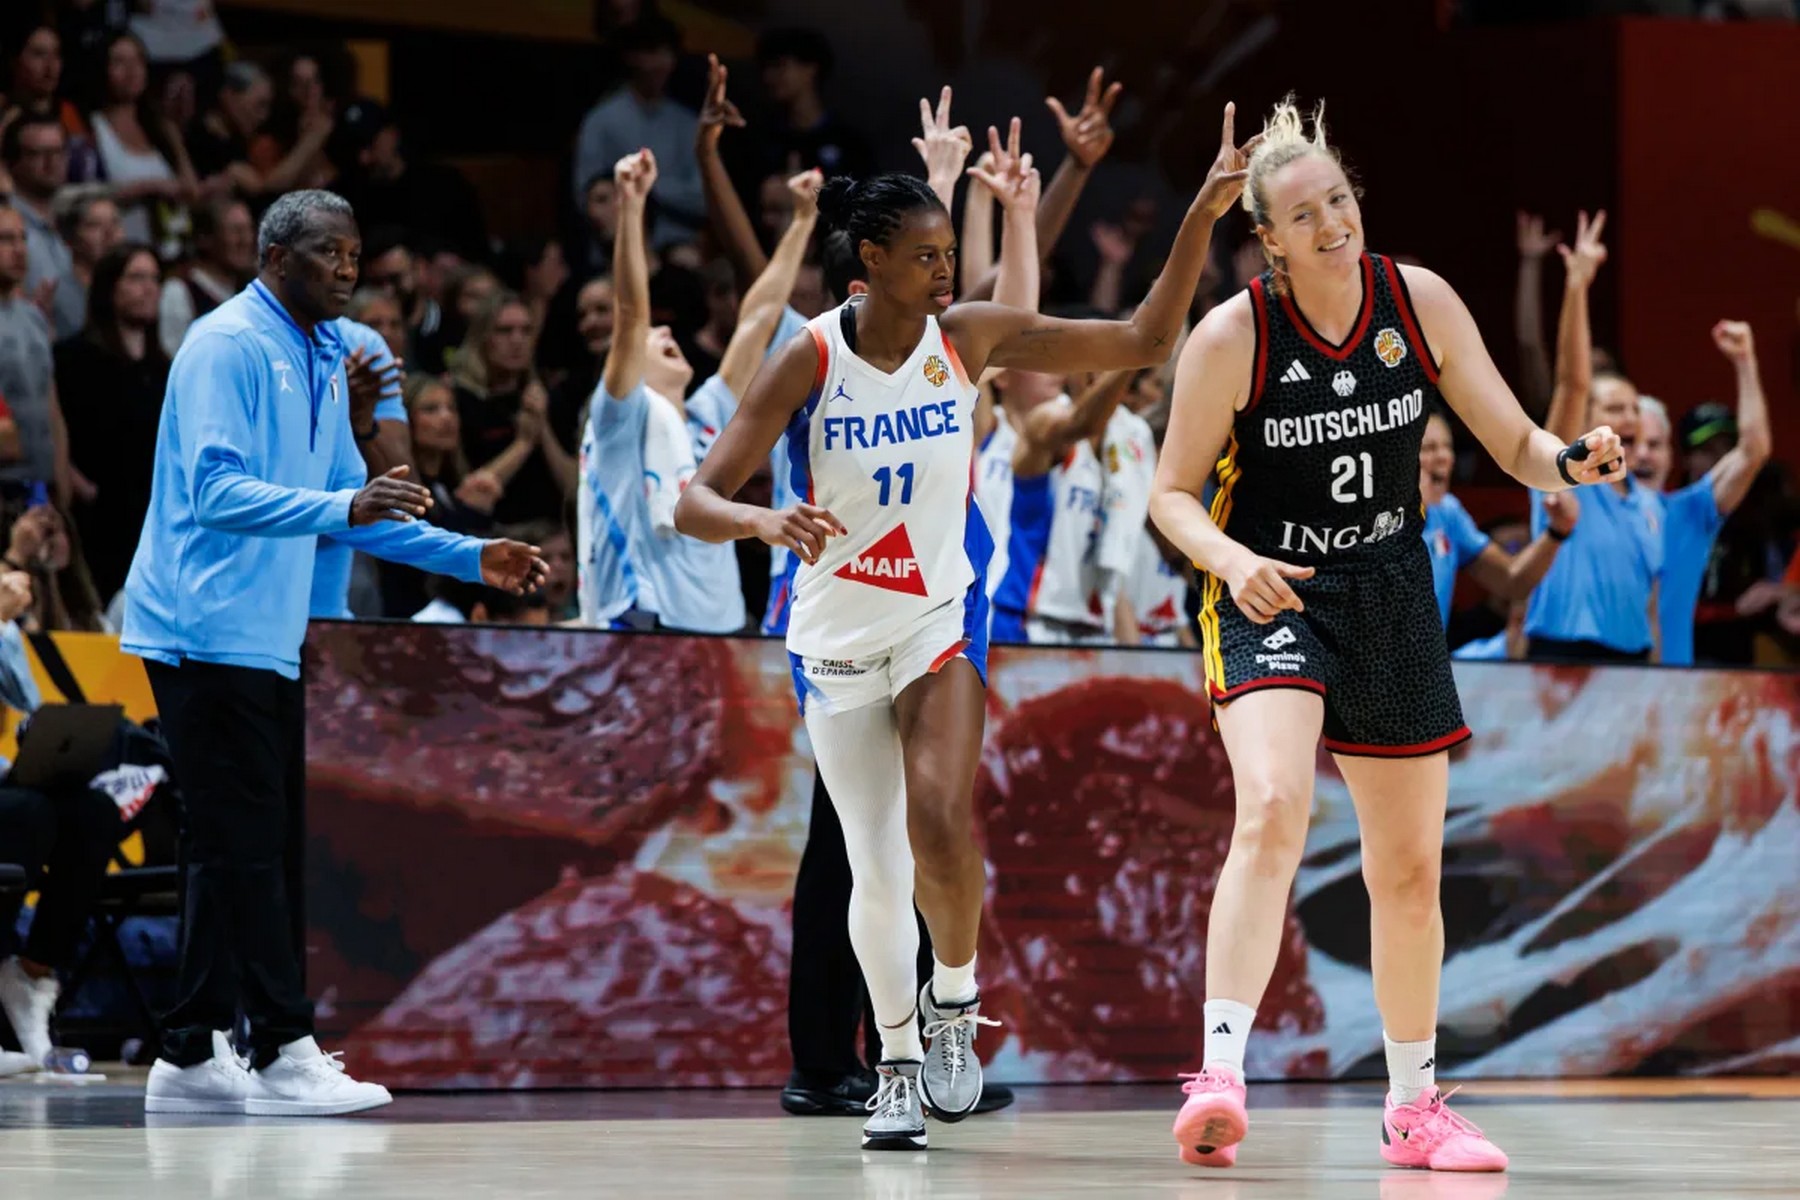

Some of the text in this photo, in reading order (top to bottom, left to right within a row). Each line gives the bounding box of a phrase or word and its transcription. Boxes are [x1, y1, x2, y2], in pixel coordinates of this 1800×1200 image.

[824, 399, 960, 450] FRANCE
[1264, 389, 1423, 448] DEUTSCHLAND
[872, 462, 914, 506] 11
[1331, 451, 1374, 504] 21
[1279, 520, 1361, 554] ING
[849, 556, 918, 579] MAIF
[1255, 651, 1306, 664] Domino's
[1268, 661, 1300, 671] Pizza
